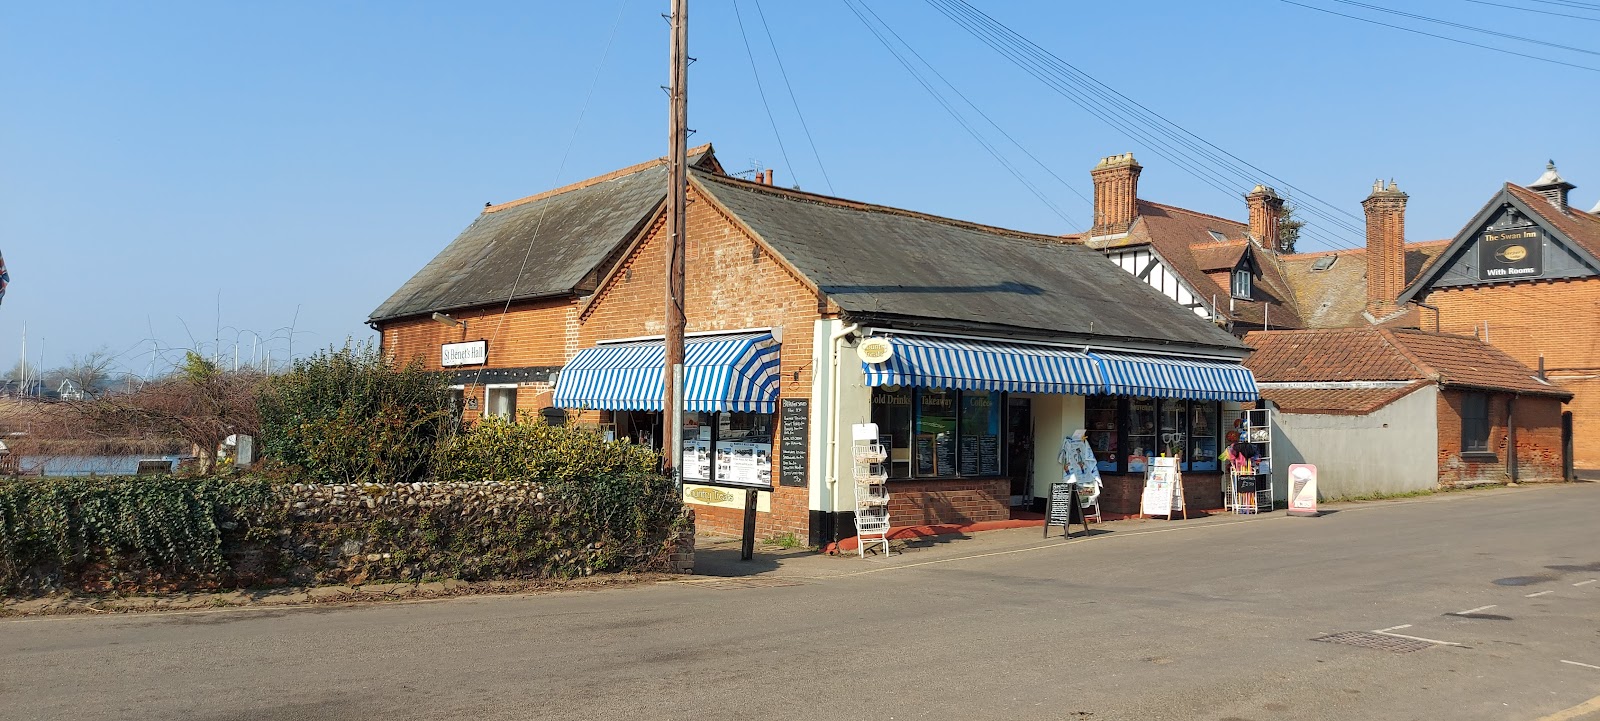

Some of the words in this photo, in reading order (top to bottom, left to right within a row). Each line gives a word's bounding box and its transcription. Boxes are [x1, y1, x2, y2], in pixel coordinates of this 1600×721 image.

[450, 348, 470, 360] Benet's
[471, 347, 483, 358] Hall
[887, 395, 911, 405] Drinks
[921, 395, 953, 409] Takeaway
[684, 486, 712, 504] Country
[712, 489, 734, 502] Treats
